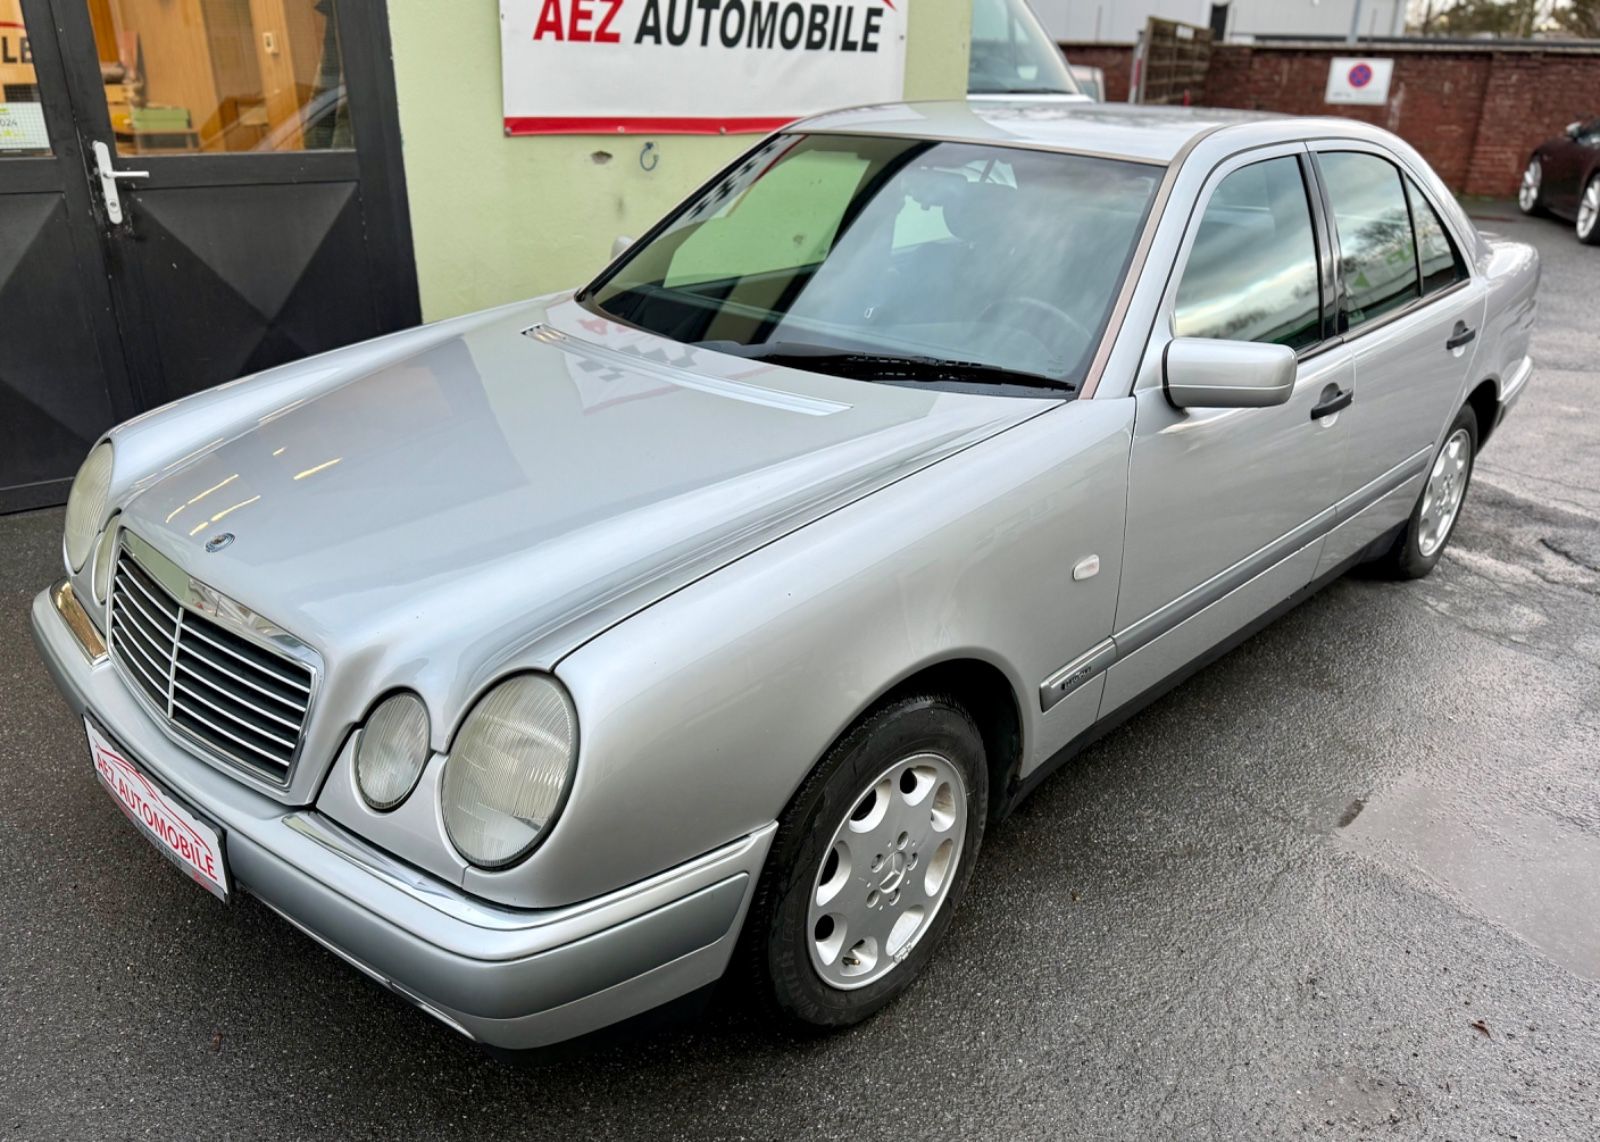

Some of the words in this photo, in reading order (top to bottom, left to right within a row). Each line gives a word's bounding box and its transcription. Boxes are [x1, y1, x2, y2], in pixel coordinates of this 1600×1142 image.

[532, 0, 625, 43] AEZ
[634, 0, 884, 53] AUTOMOBILE
[96, 752, 118, 790] AEZ
[118, 778, 218, 882] AUTOMOBILE
